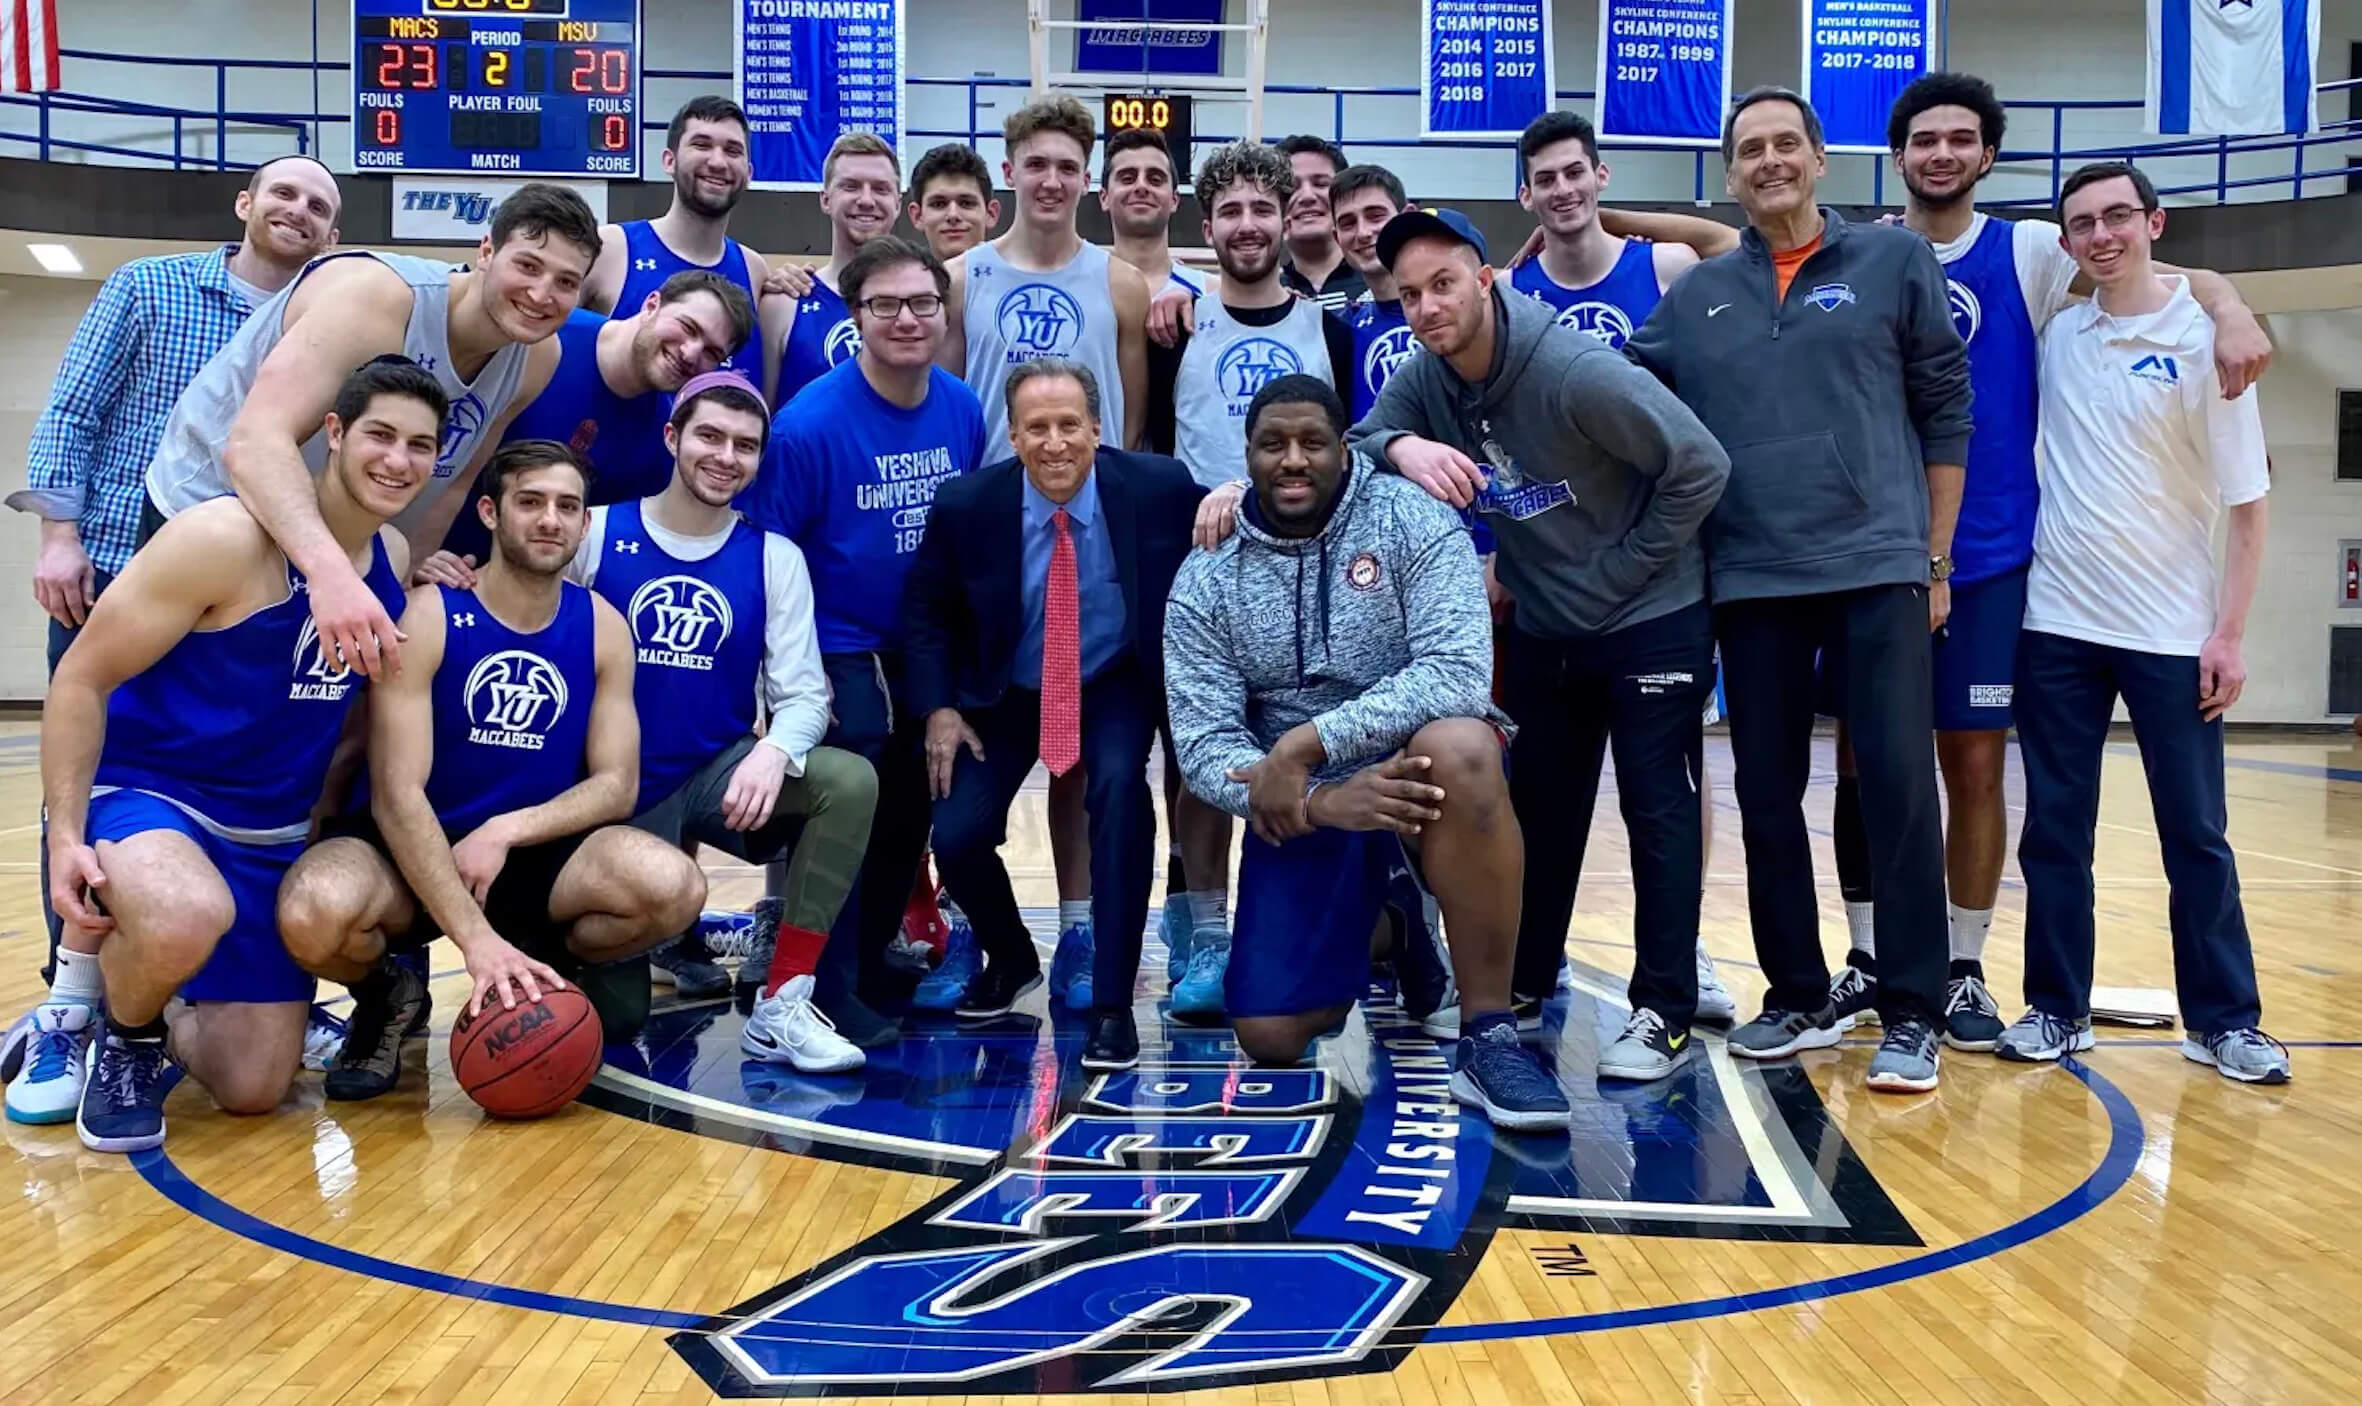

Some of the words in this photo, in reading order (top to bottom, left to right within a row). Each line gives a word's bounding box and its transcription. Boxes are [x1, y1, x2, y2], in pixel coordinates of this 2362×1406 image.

[751, 1, 890, 20] TOURNAMENT
[1437, 2, 1476, 12] SKYLINE
[1477, 3, 1537, 13] CONFERENCE
[1614, 7, 1655, 17] SKYLINE
[1656, 9, 1718, 20] CONFERENCE
[1826, 2, 1854, 11] MEN'S
[1856, 2, 1913, 12] BASKETBALL
[389, 18, 439, 39] MACS
[1435, 15, 1540, 32] CHAMPIONS
[1612, 20, 1720, 39] CHAMPIONS
[1817, 17, 1858, 27] SKYLINE
[1859, 18, 1920, 28] CONFERENCE
[471, 31, 521, 46] PERIOD
[1440, 38, 1482, 54] 2014
[1493, 38, 1536, 55] 2015
[1816, 30, 1921, 47] CHAMPIONS
[1671, 45, 1716, 61] 1999
[1822, 53, 1915, 69] 2017-2018
[379, 44, 437, 88] 23
[485, 52, 508, 86] 2
[571, 49, 627, 92] 20
[1440, 62, 1483, 77] 2016
[1495, 62, 1536, 77] 2017
[1616, 65, 1659, 82] 2017
[359, 93, 404, 108] FOULS
[1440, 85, 1484, 101] 2018
[449, 95, 501, 111] PLAYER
[507, 97, 542, 112] FOUL
[587, 98, 632, 113] FOULS
[1111, 100, 1169, 128] 00.0
[376, 110, 397, 144] 0
[604, 115, 625, 149] 0
[358, 151, 404, 167] SCORE
[471, 154, 521, 169] MATCH
[586, 156, 631, 172] SCORE
[402, 191, 452, 211] THE
[452, 192, 493, 225] YU
[875, 446, 953, 481] YESHIVA
[894, 529, 926, 554] 18
[650, 603, 716, 653] YU
[637, 648, 714, 671] MACCABEES
[483, 682, 550, 731] YU
[468, 727, 545, 750] MACCABEES
[484, 1004, 555, 1060] NCAA
[1345, 1038, 1461, 1235] UNIVERSITY
[1530, 1243, 1598, 1276] TM
